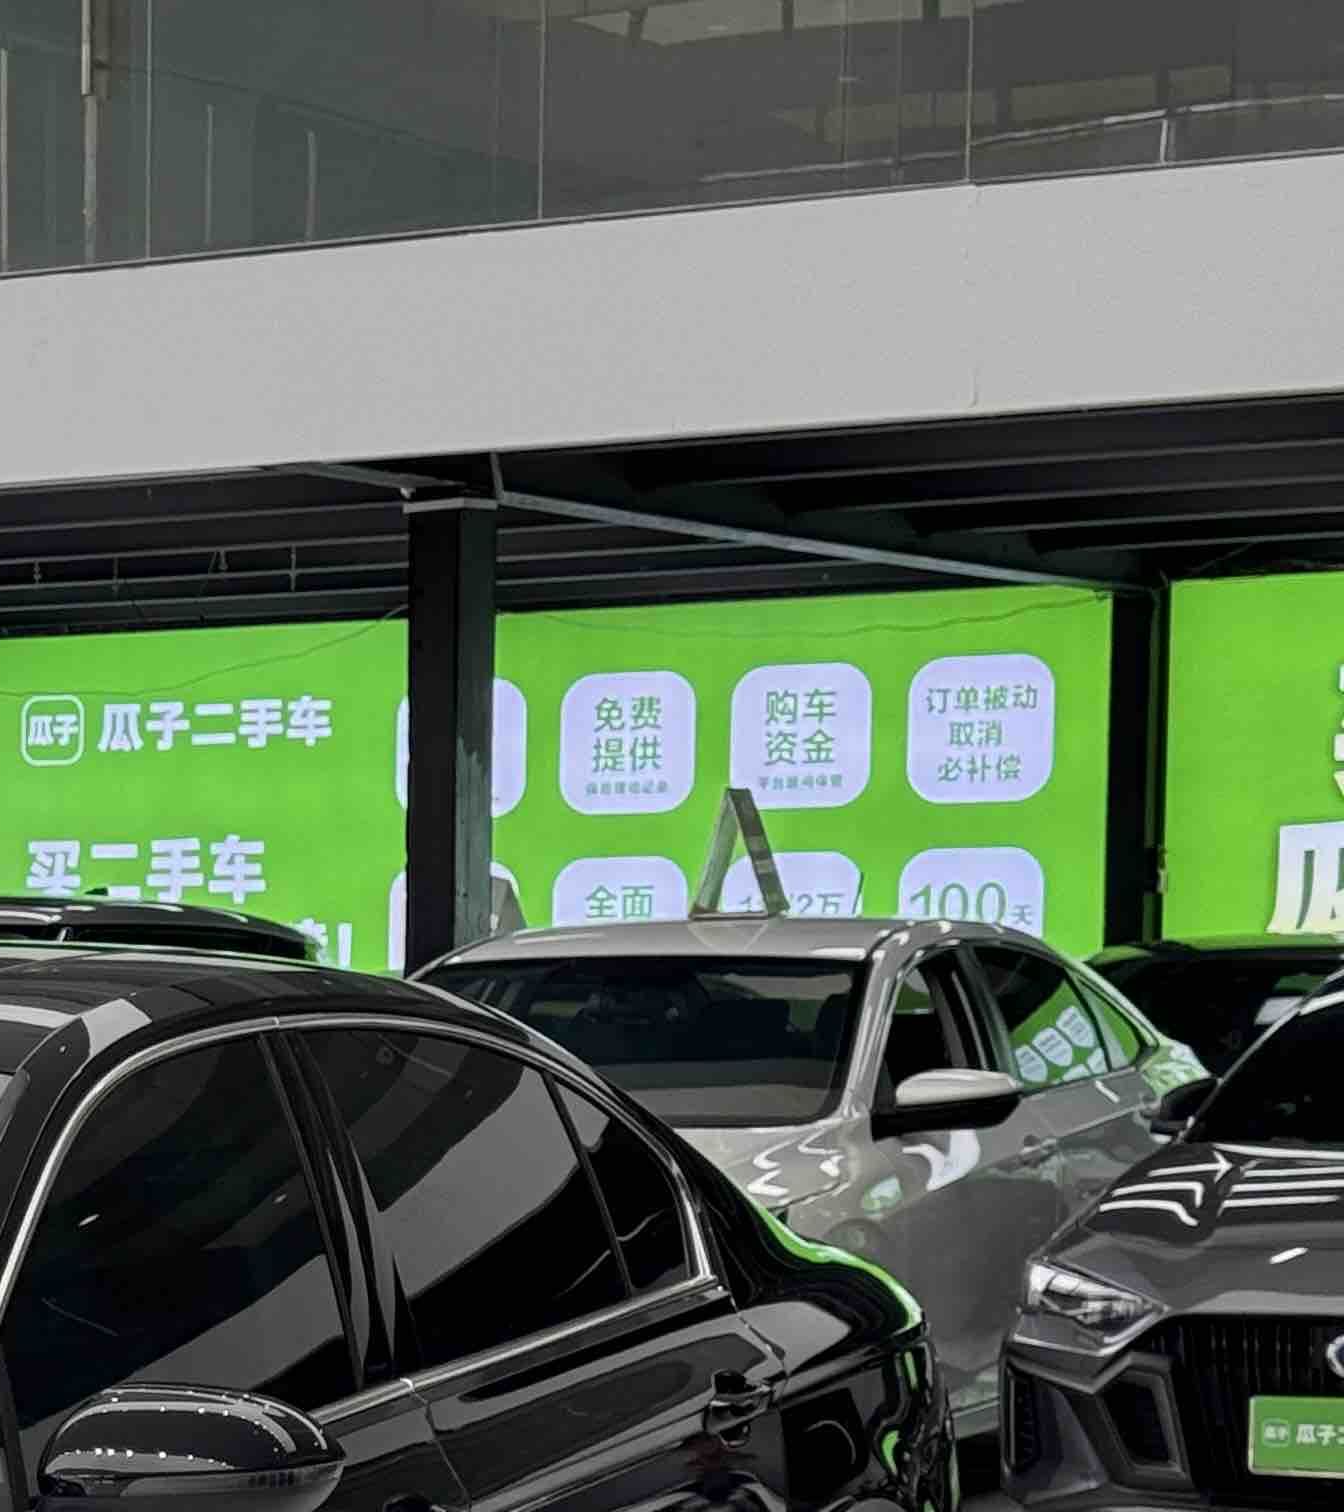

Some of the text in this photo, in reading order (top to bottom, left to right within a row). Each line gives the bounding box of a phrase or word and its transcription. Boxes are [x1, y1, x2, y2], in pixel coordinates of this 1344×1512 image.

[593, 696, 663, 733] 免费
[764, 689, 837, 726] 购车
[926, 683, 1039, 714] 订单被动
[27, 714, 79, 747] 瓜子
[97, 695, 332, 751] 瓜子二手车
[948, 720, 1003, 747] 取消
[592, 736, 663, 773] 提供
[764, 729, 836, 766] 资金
[937, 755, 1022, 783] 必补偿
[25, 834, 267, 905] 买二手车
[585, 885, 655, 920] 全面
